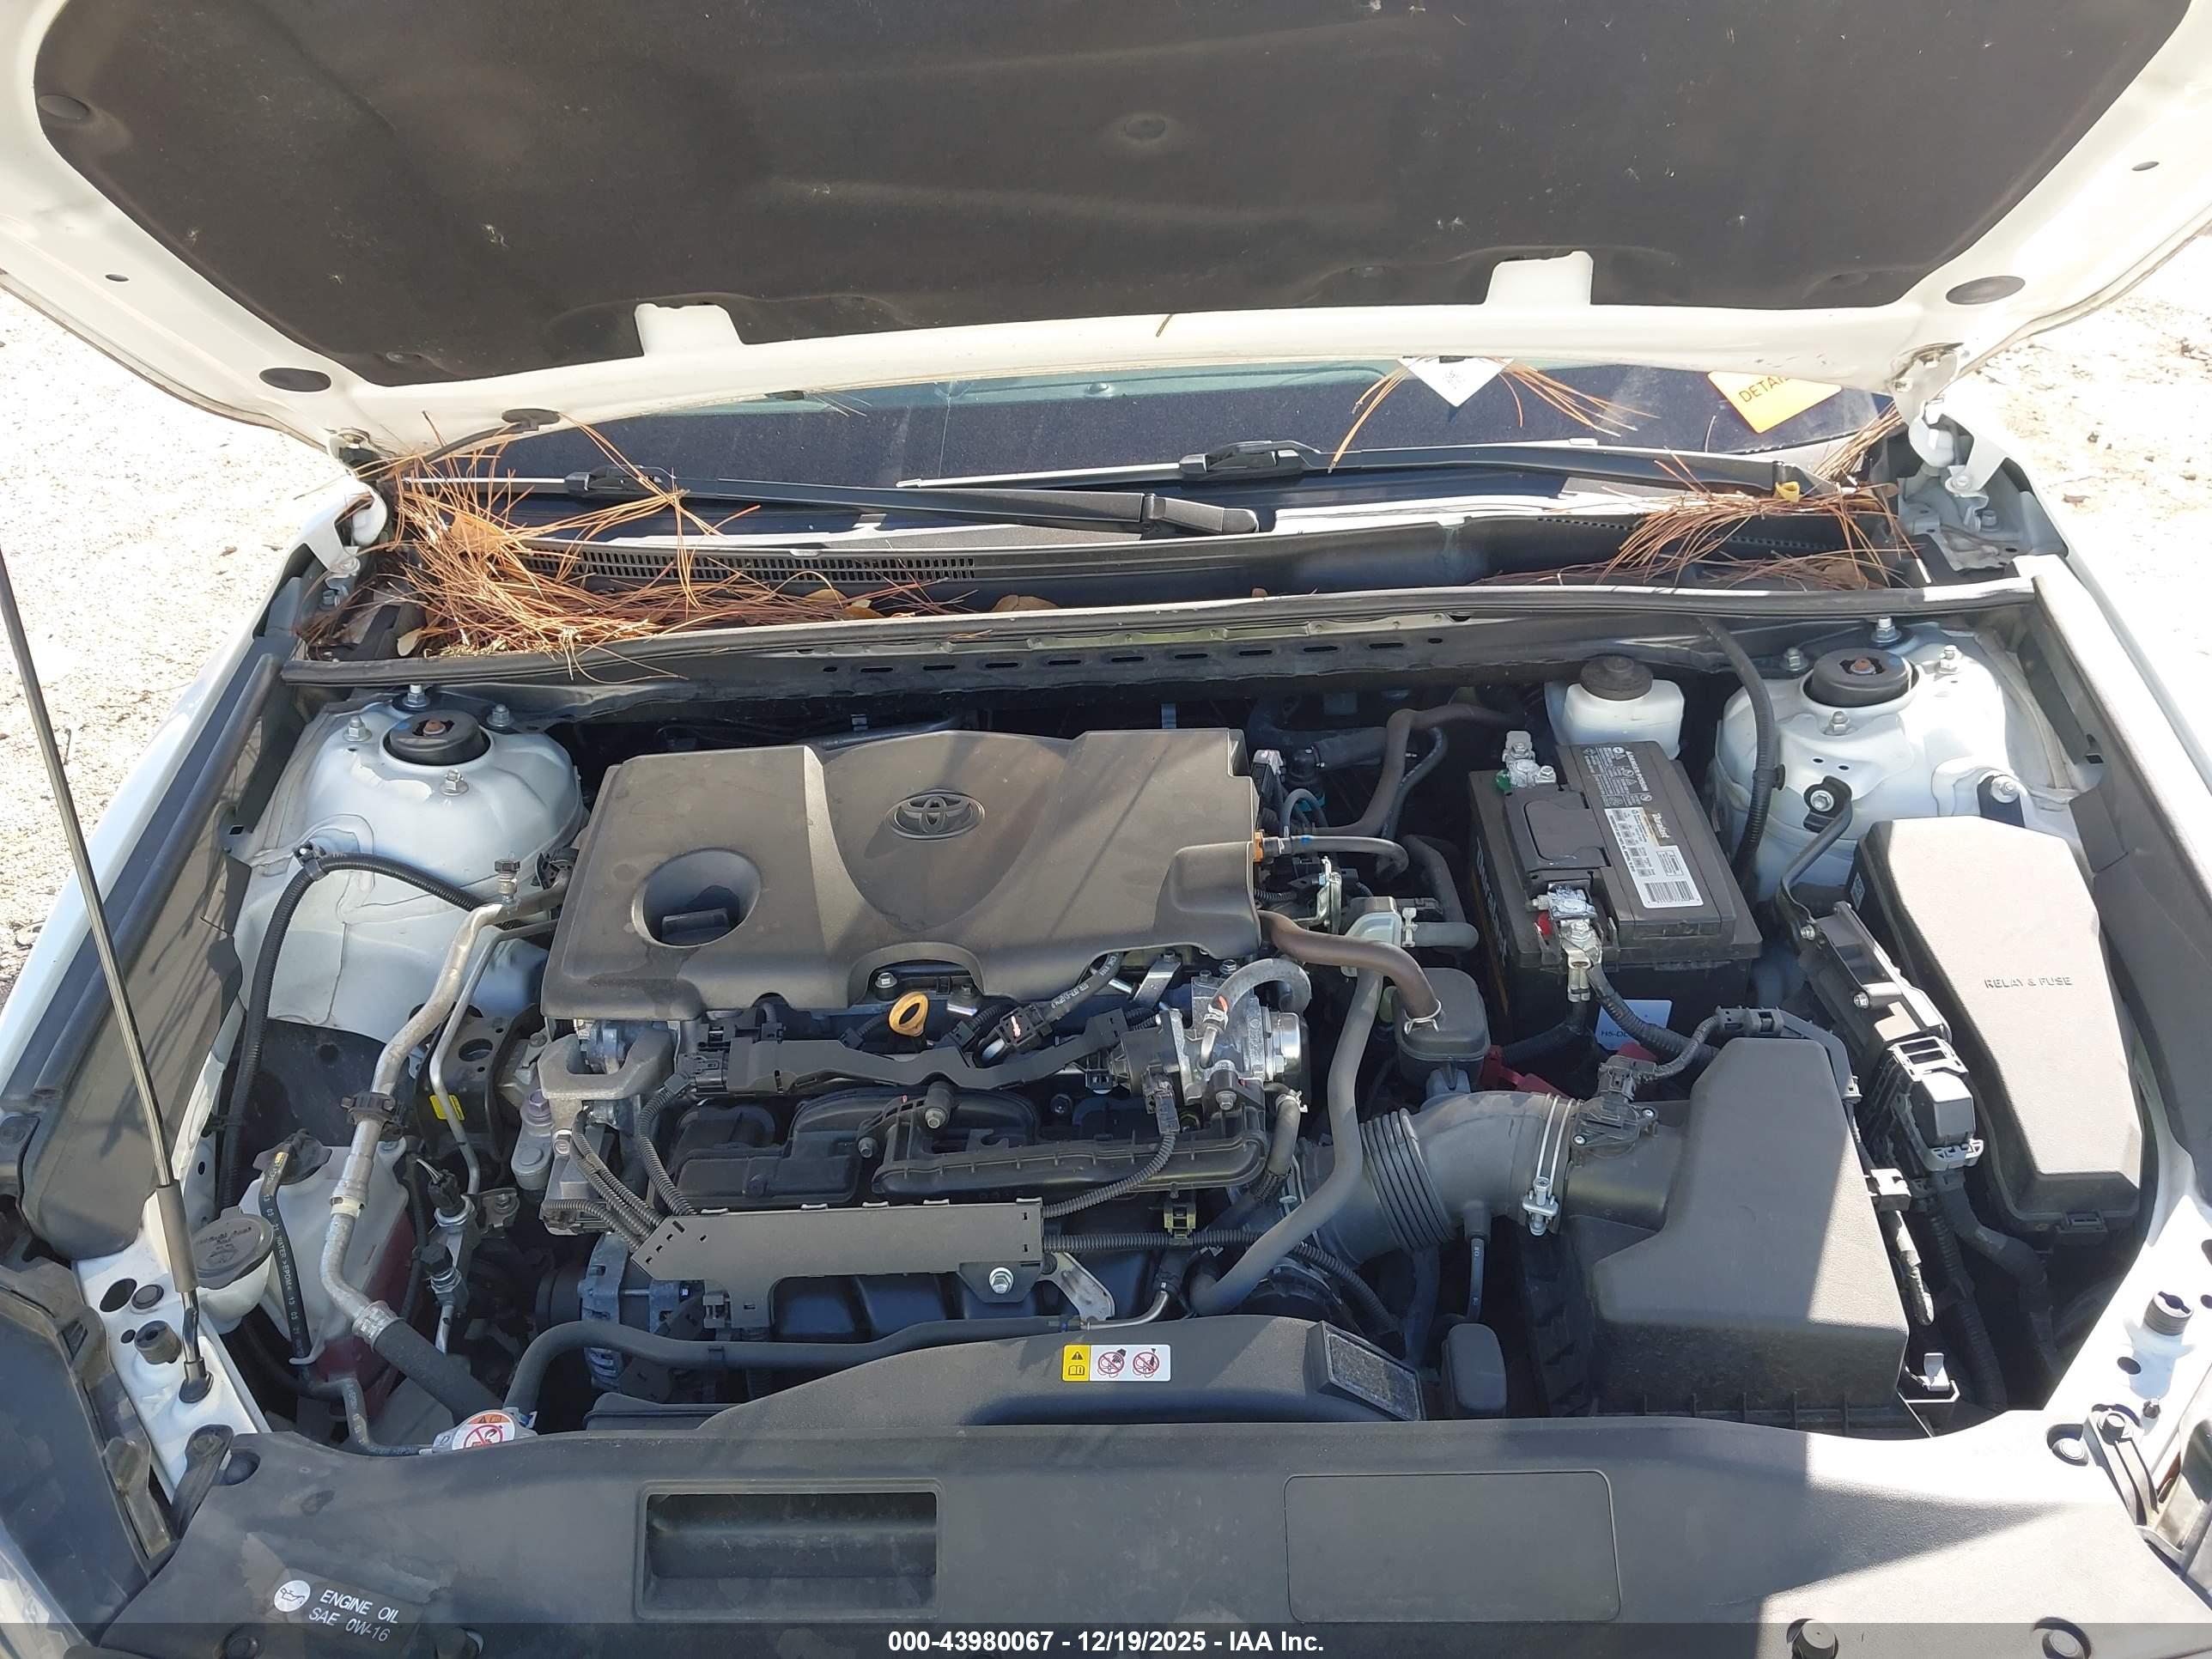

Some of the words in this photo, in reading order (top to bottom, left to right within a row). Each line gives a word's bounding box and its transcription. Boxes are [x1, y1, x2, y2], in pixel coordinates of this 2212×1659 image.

[1984, 978, 2023, 989] RELAY
[2039, 976, 2074, 987] FUSE
[276, 1235, 288, 1259] WATER
[319, 1589, 374, 1615] ENGINE
[378, 1607, 400, 1624] OIL
[308, 1607, 341, 1626] SAE
[344, 1618, 391, 1642] 0W-16
